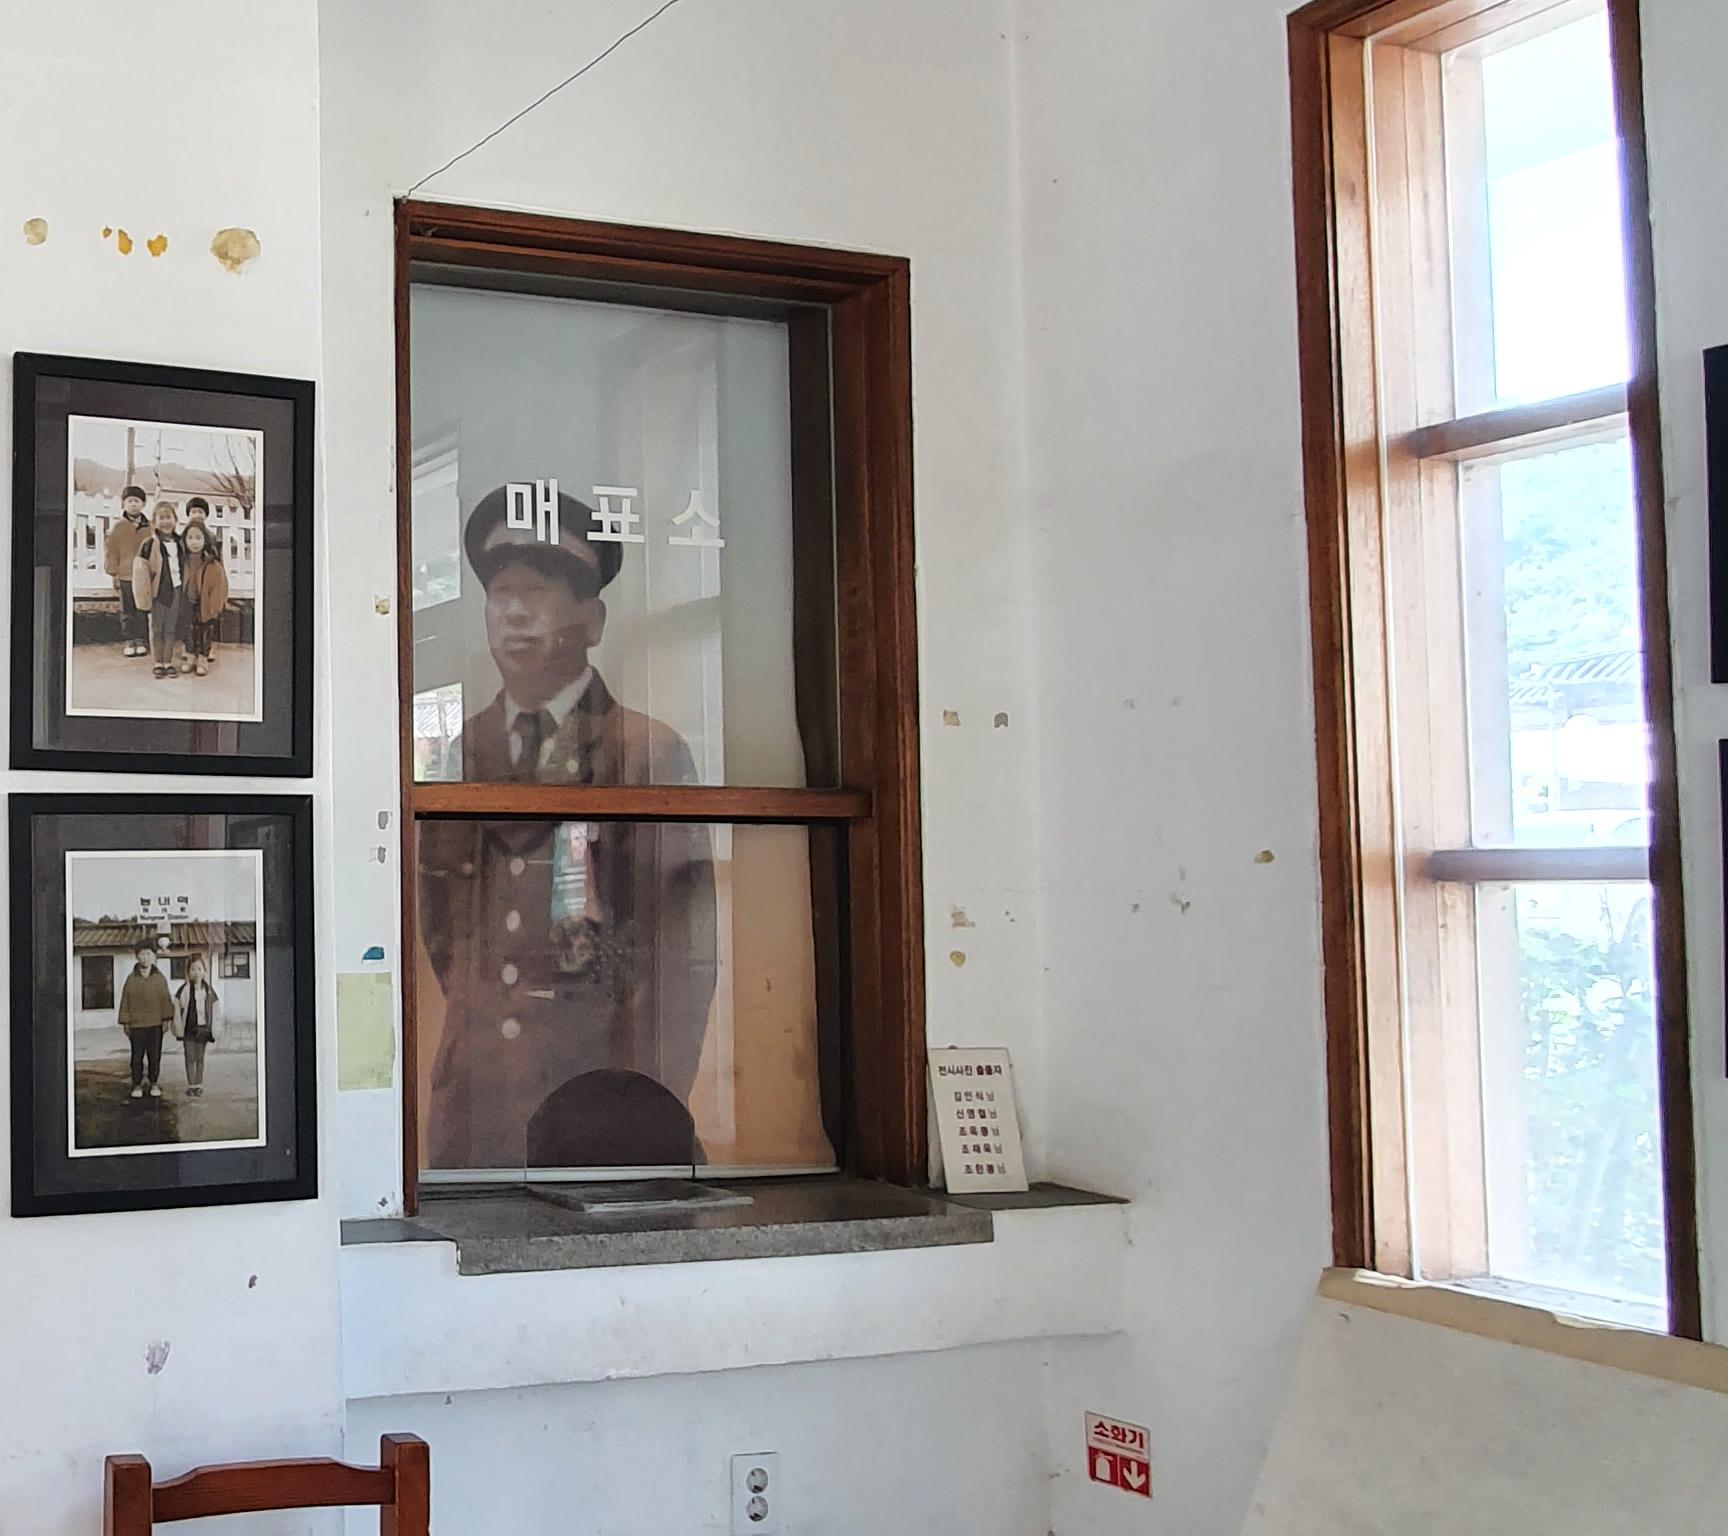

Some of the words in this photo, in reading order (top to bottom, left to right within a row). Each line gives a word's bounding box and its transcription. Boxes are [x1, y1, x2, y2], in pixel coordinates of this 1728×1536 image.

[505, 477, 726, 549] 매표소
[938, 1064, 973, 1076] 전시사진
[1093, 1420, 1145, 1449] 소화기
